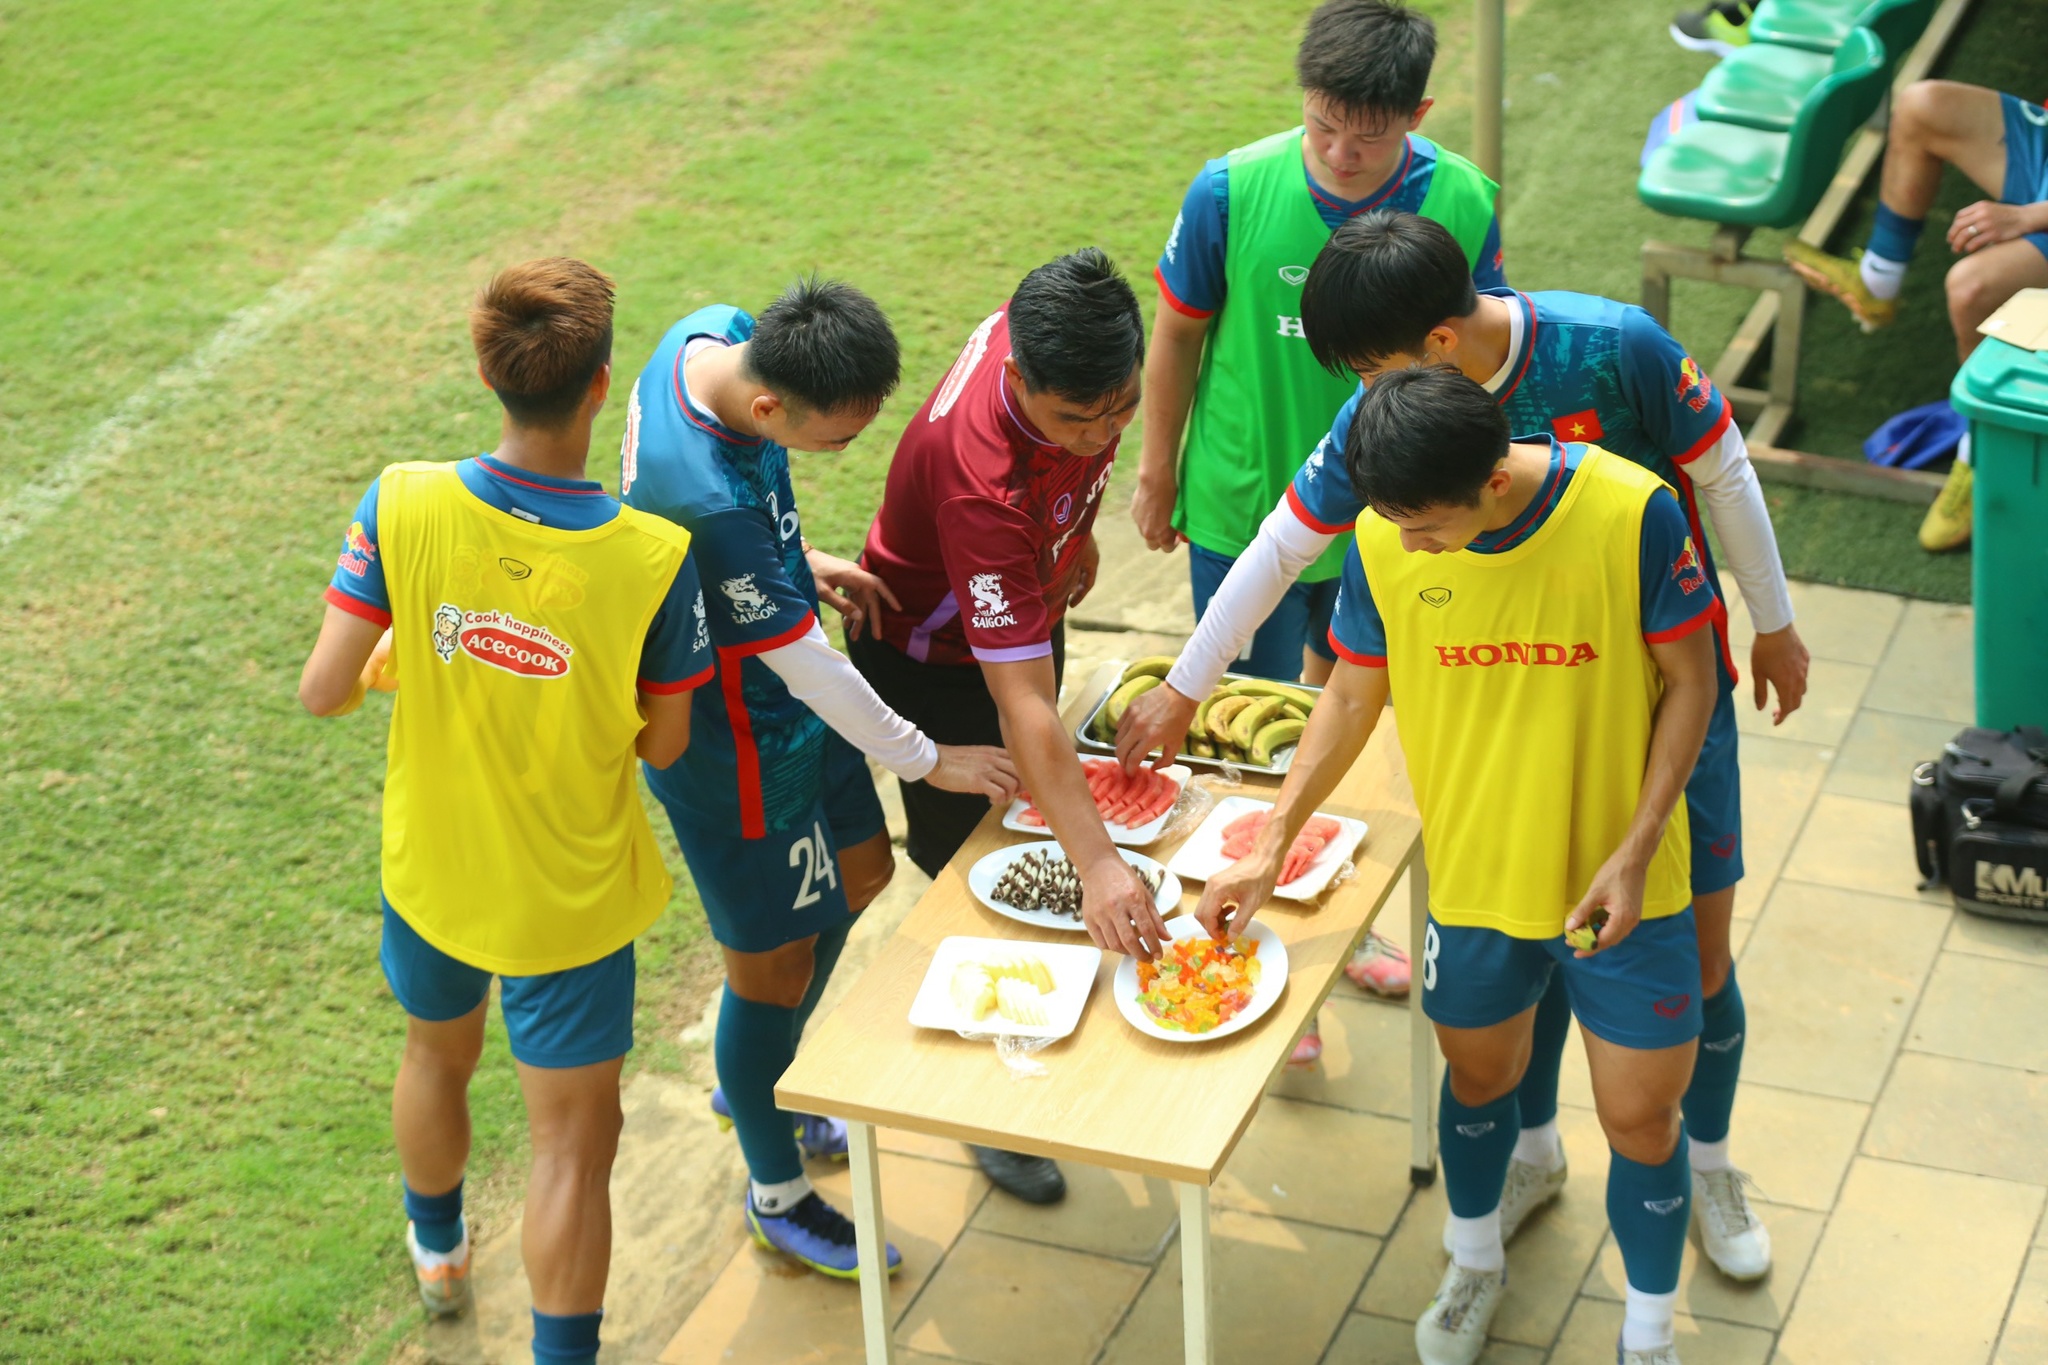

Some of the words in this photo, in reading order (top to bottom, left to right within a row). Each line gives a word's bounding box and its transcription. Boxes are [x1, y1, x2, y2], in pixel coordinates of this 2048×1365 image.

[465, 612, 500, 624] Cook
[504, 615, 572, 655] happiness
[1434, 642, 1599, 668] HONDA
[789, 820, 837, 911] 24
